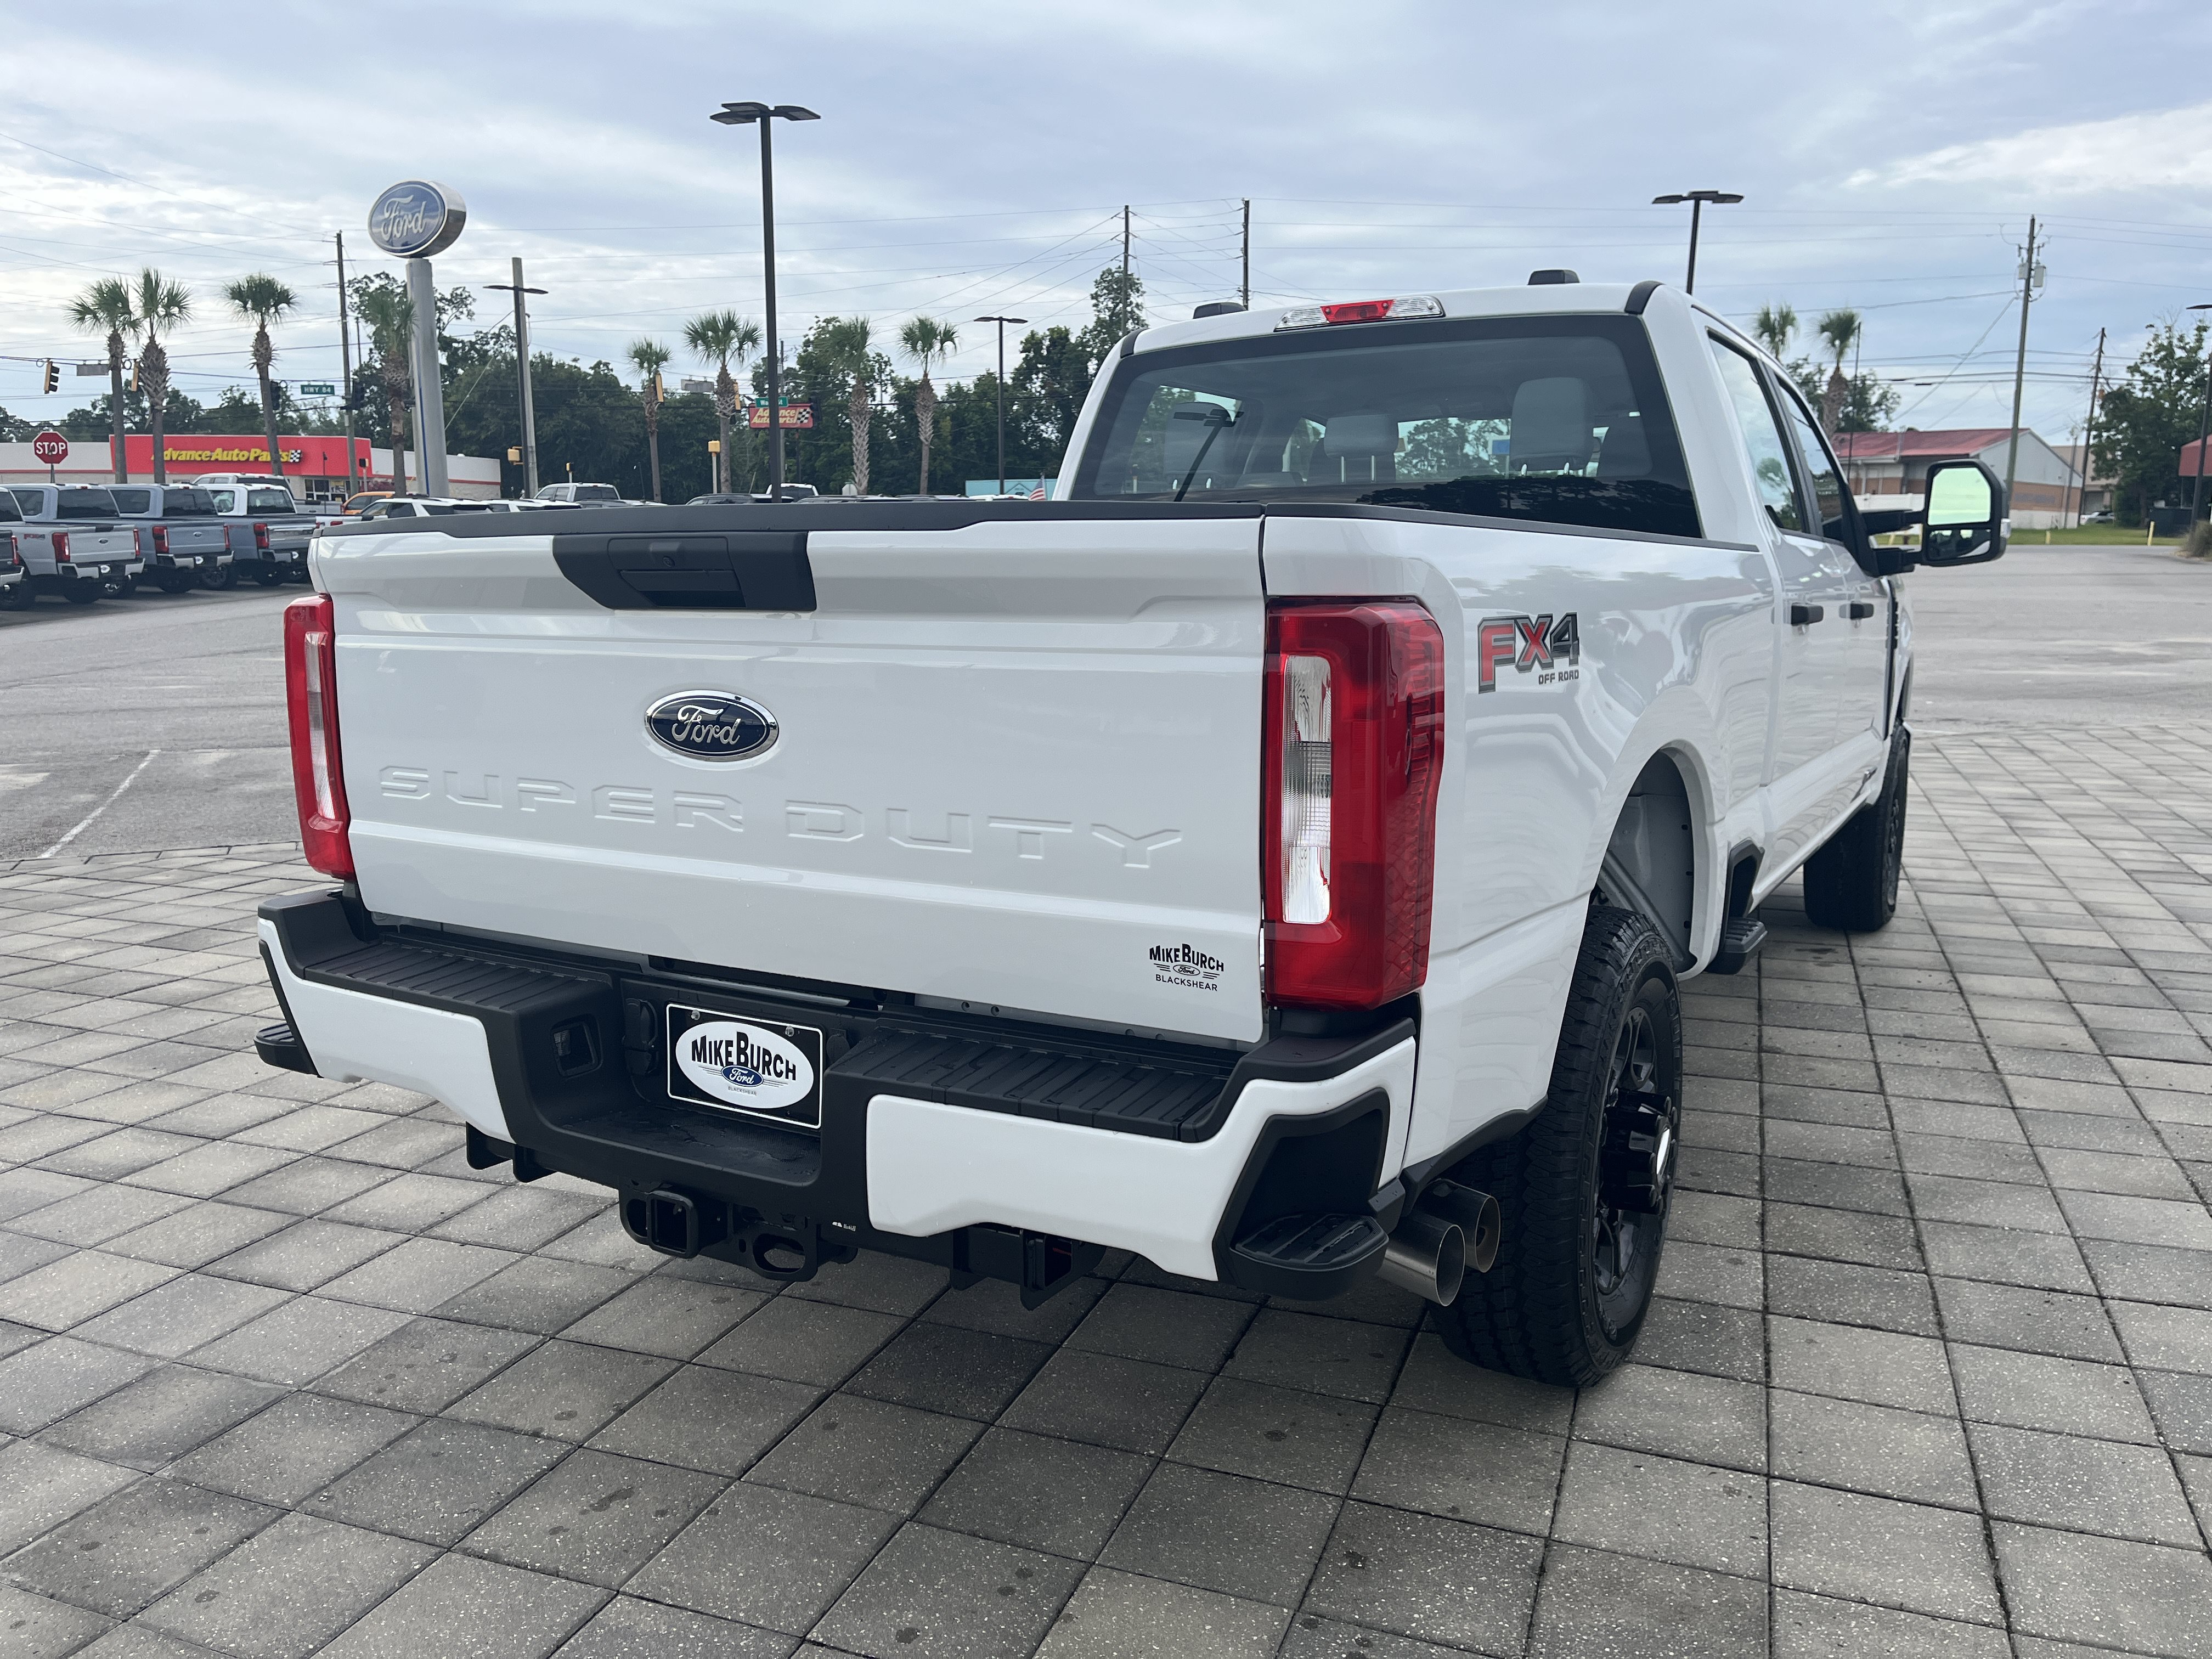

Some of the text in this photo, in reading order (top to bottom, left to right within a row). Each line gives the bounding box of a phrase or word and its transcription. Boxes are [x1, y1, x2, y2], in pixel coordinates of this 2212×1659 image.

[381, 195, 426, 241] Ford
[756, 408, 795, 417] Adnce
[36, 442, 66, 455] STOP
[151, 448, 211, 461] dvance
[211, 448, 249, 461] Auto
[1477, 612, 1580, 695] FX4
[1538, 669, 1579, 685] OFF ROAD
[672, 704, 741, 745] Ford
[379, 765, 1183, 868] SUPER DUTY
[1178, 964, 1195, 974] Ford
[1155, 973, 1218, 992] BLACKSHEAR
[729, 1068, 754, 1085] Ford
[728, 1086, 757, 1096] BLACKSHEAR
